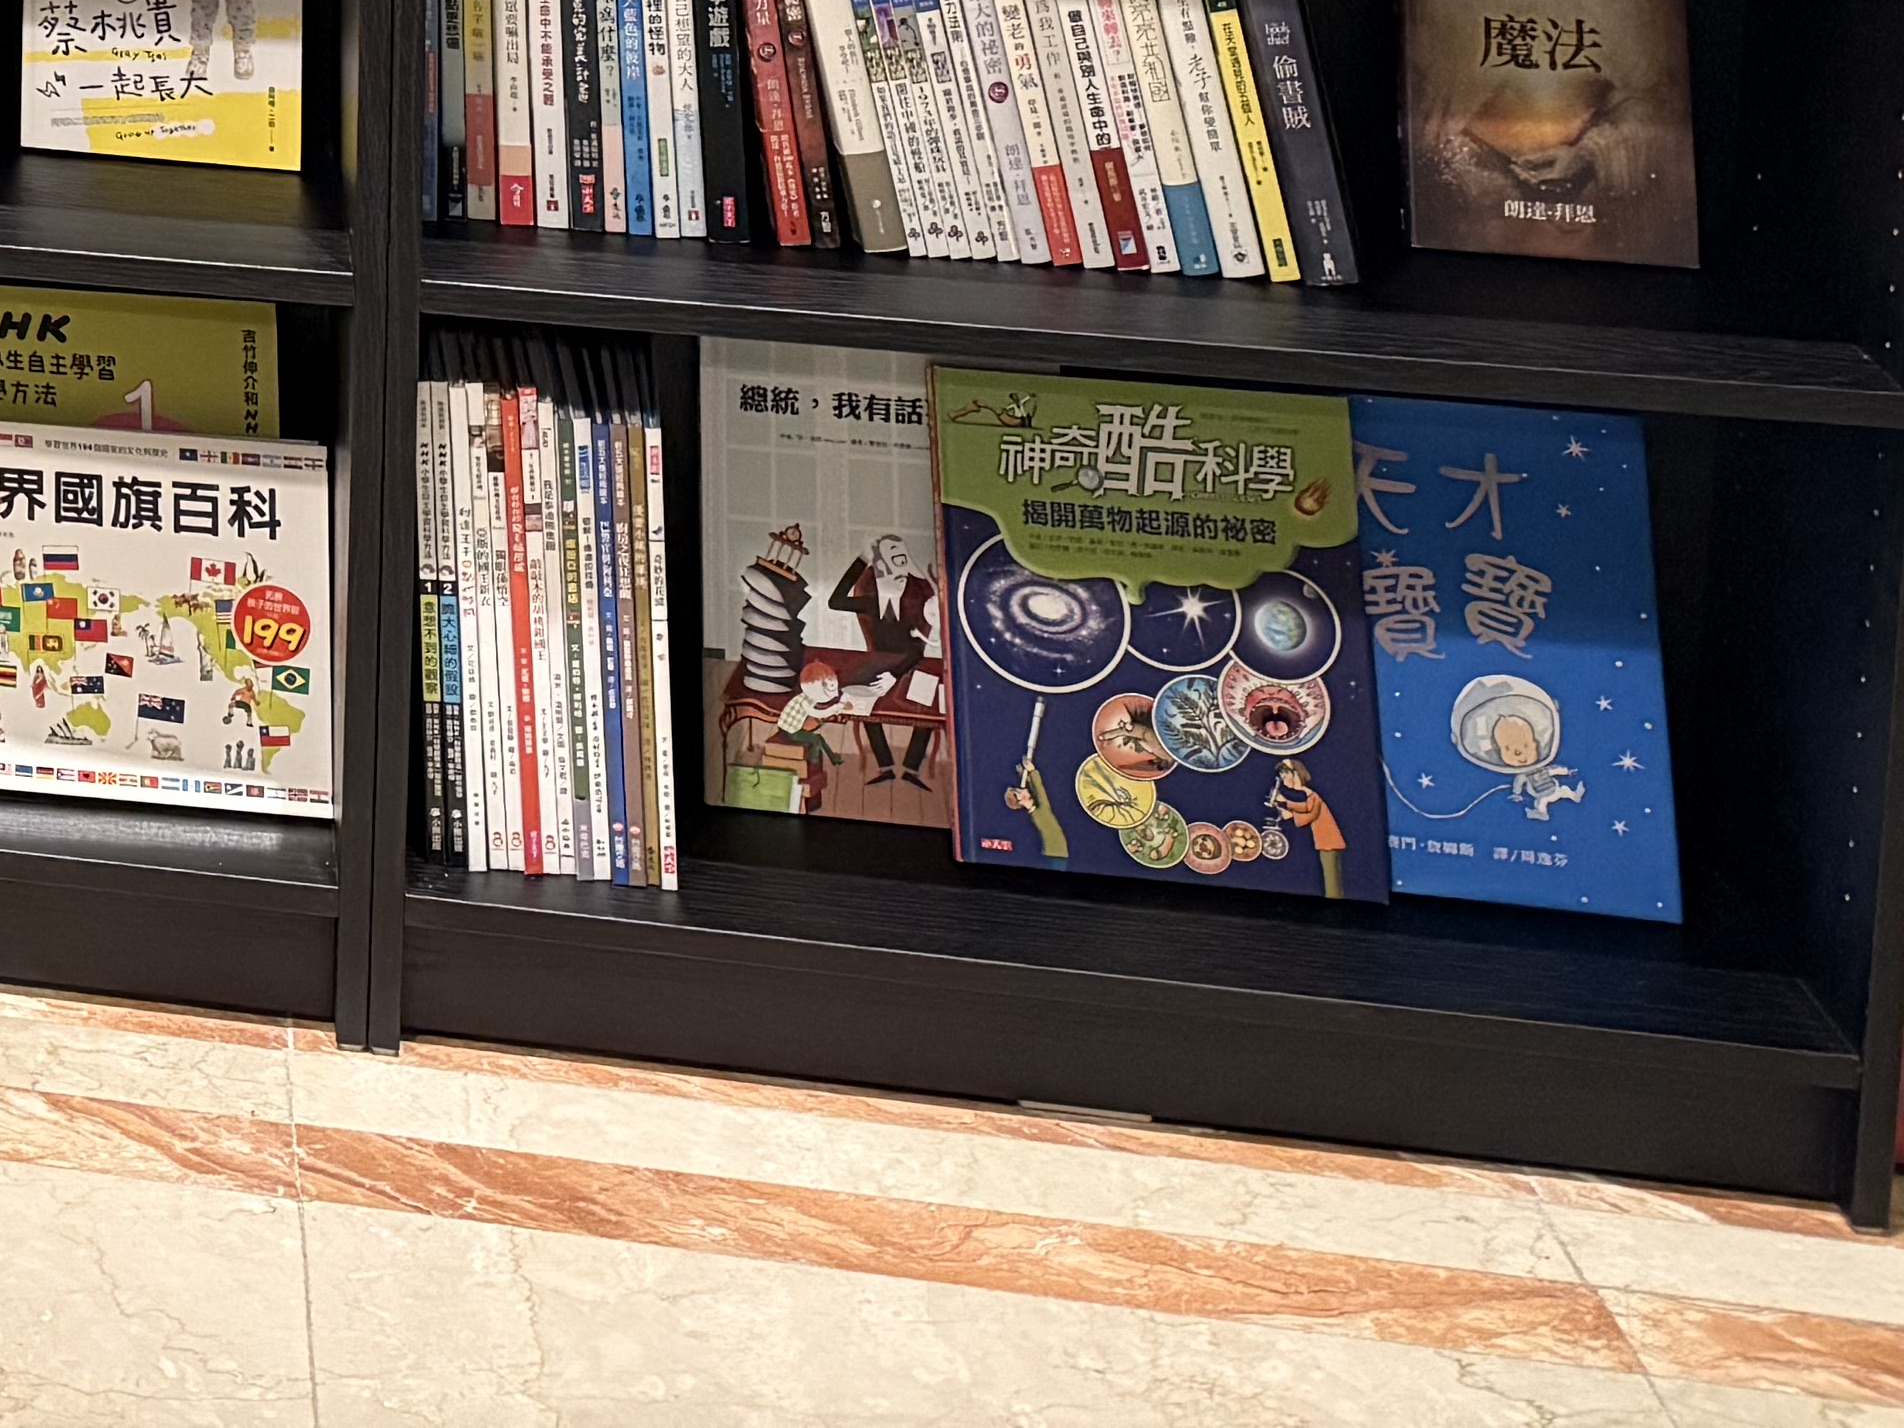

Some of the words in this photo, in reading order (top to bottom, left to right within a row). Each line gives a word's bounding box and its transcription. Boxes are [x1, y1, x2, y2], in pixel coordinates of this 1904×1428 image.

[1001, 4, 1039, 90] 變老的勇氣
[1480, 13, 1603, 73] 魔法
[79, 66, 214, 102] 一起長大
[1272, 55, 1311, 130] 偷書賊
[123, 380, 154, 432] 1
[740, 384, 931, 427] 總統，我有話
[998, 402, 1295, 501] 神奇酷科學
[1356, 442, 1527, 543] 天才
[243, 614, 306, 651] 199
[1361, 552, 1555, 662] 寶寶
[423, 600, 438, 697] 意想不到的觀察
